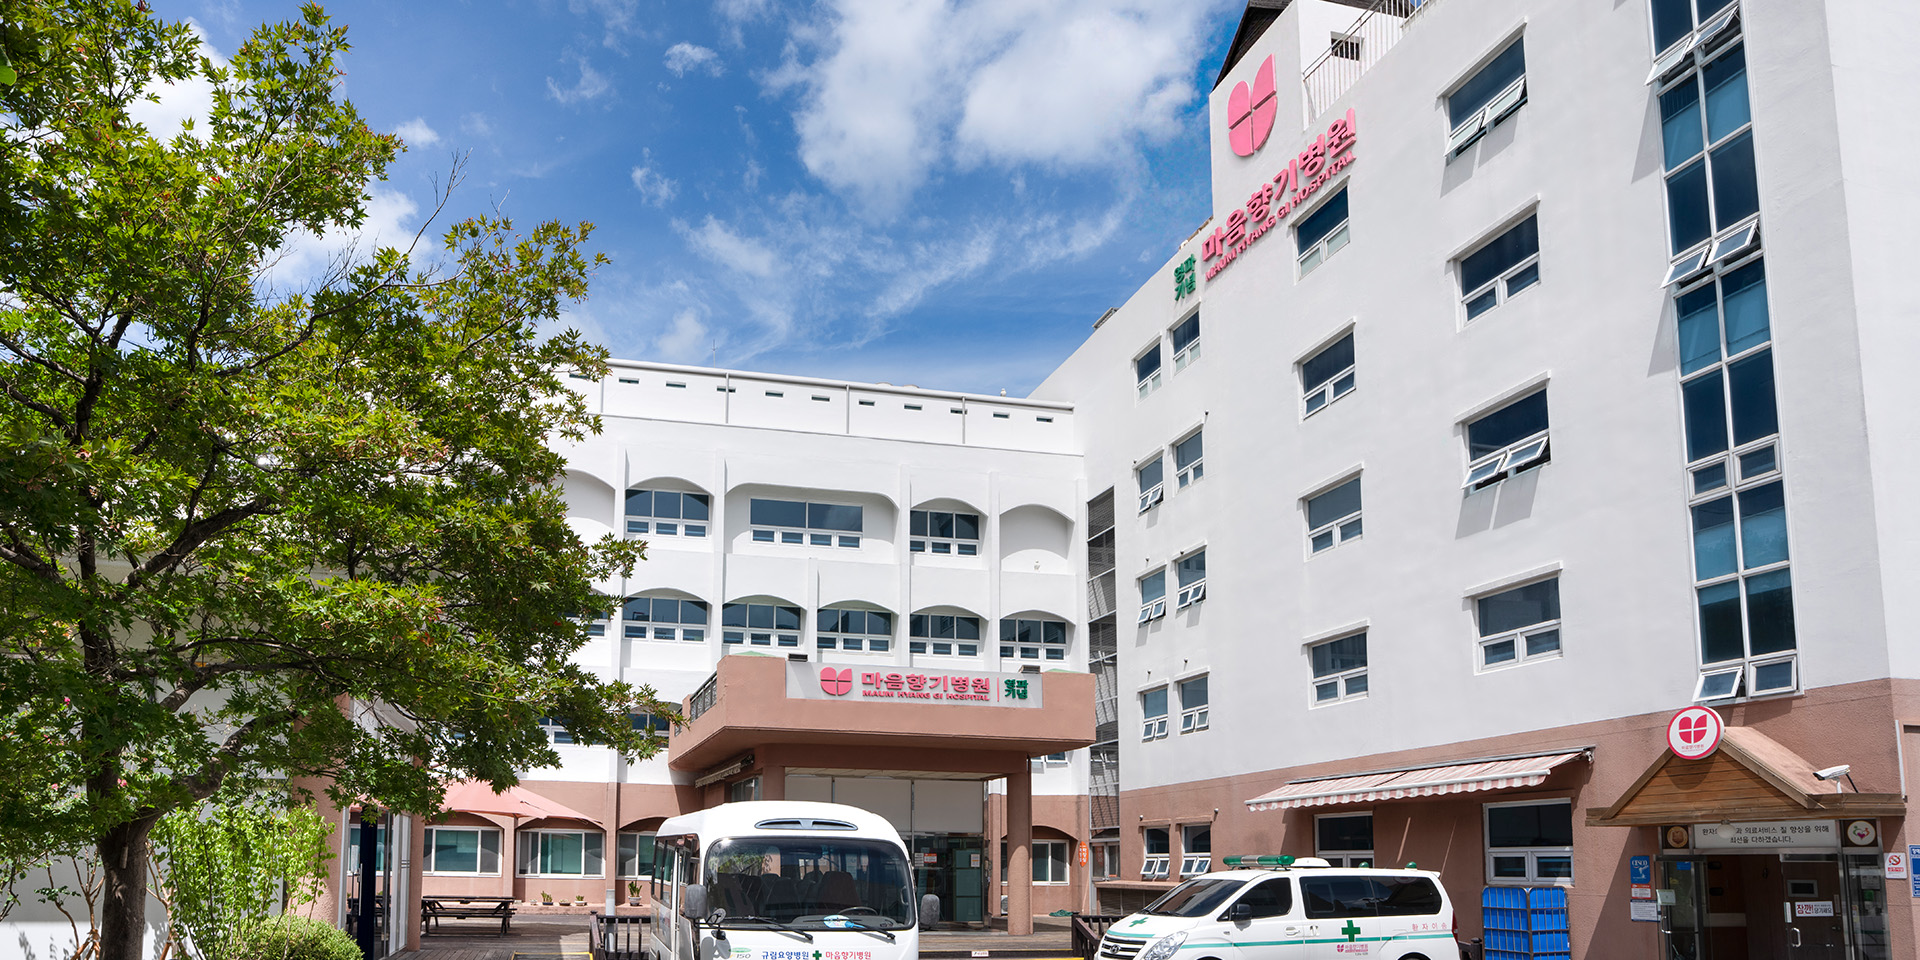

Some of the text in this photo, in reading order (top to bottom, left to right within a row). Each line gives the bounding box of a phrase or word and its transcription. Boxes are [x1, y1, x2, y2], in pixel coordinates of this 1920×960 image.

[1202, 108, 1356, 262] 마음향기병원
[1205, 150, 1357, 282] MAUM HYANG GI HOSPITAL
[1174, 253, 1197, 284] 영파
[1175, 272, 1196, 302] 기념
[861, 671, 990, 693] 마음향기병원
[1004, 679, 1028, 689] 영파
[862, 690, 990, 701] MAUM HYANG GI HOSPITAL
[1004, 688, 1028, 699] 기념
[1790, 825, 1811, 834] 향상을
[761, 951, 871, 960] 규림요양병원 마음향기병원
